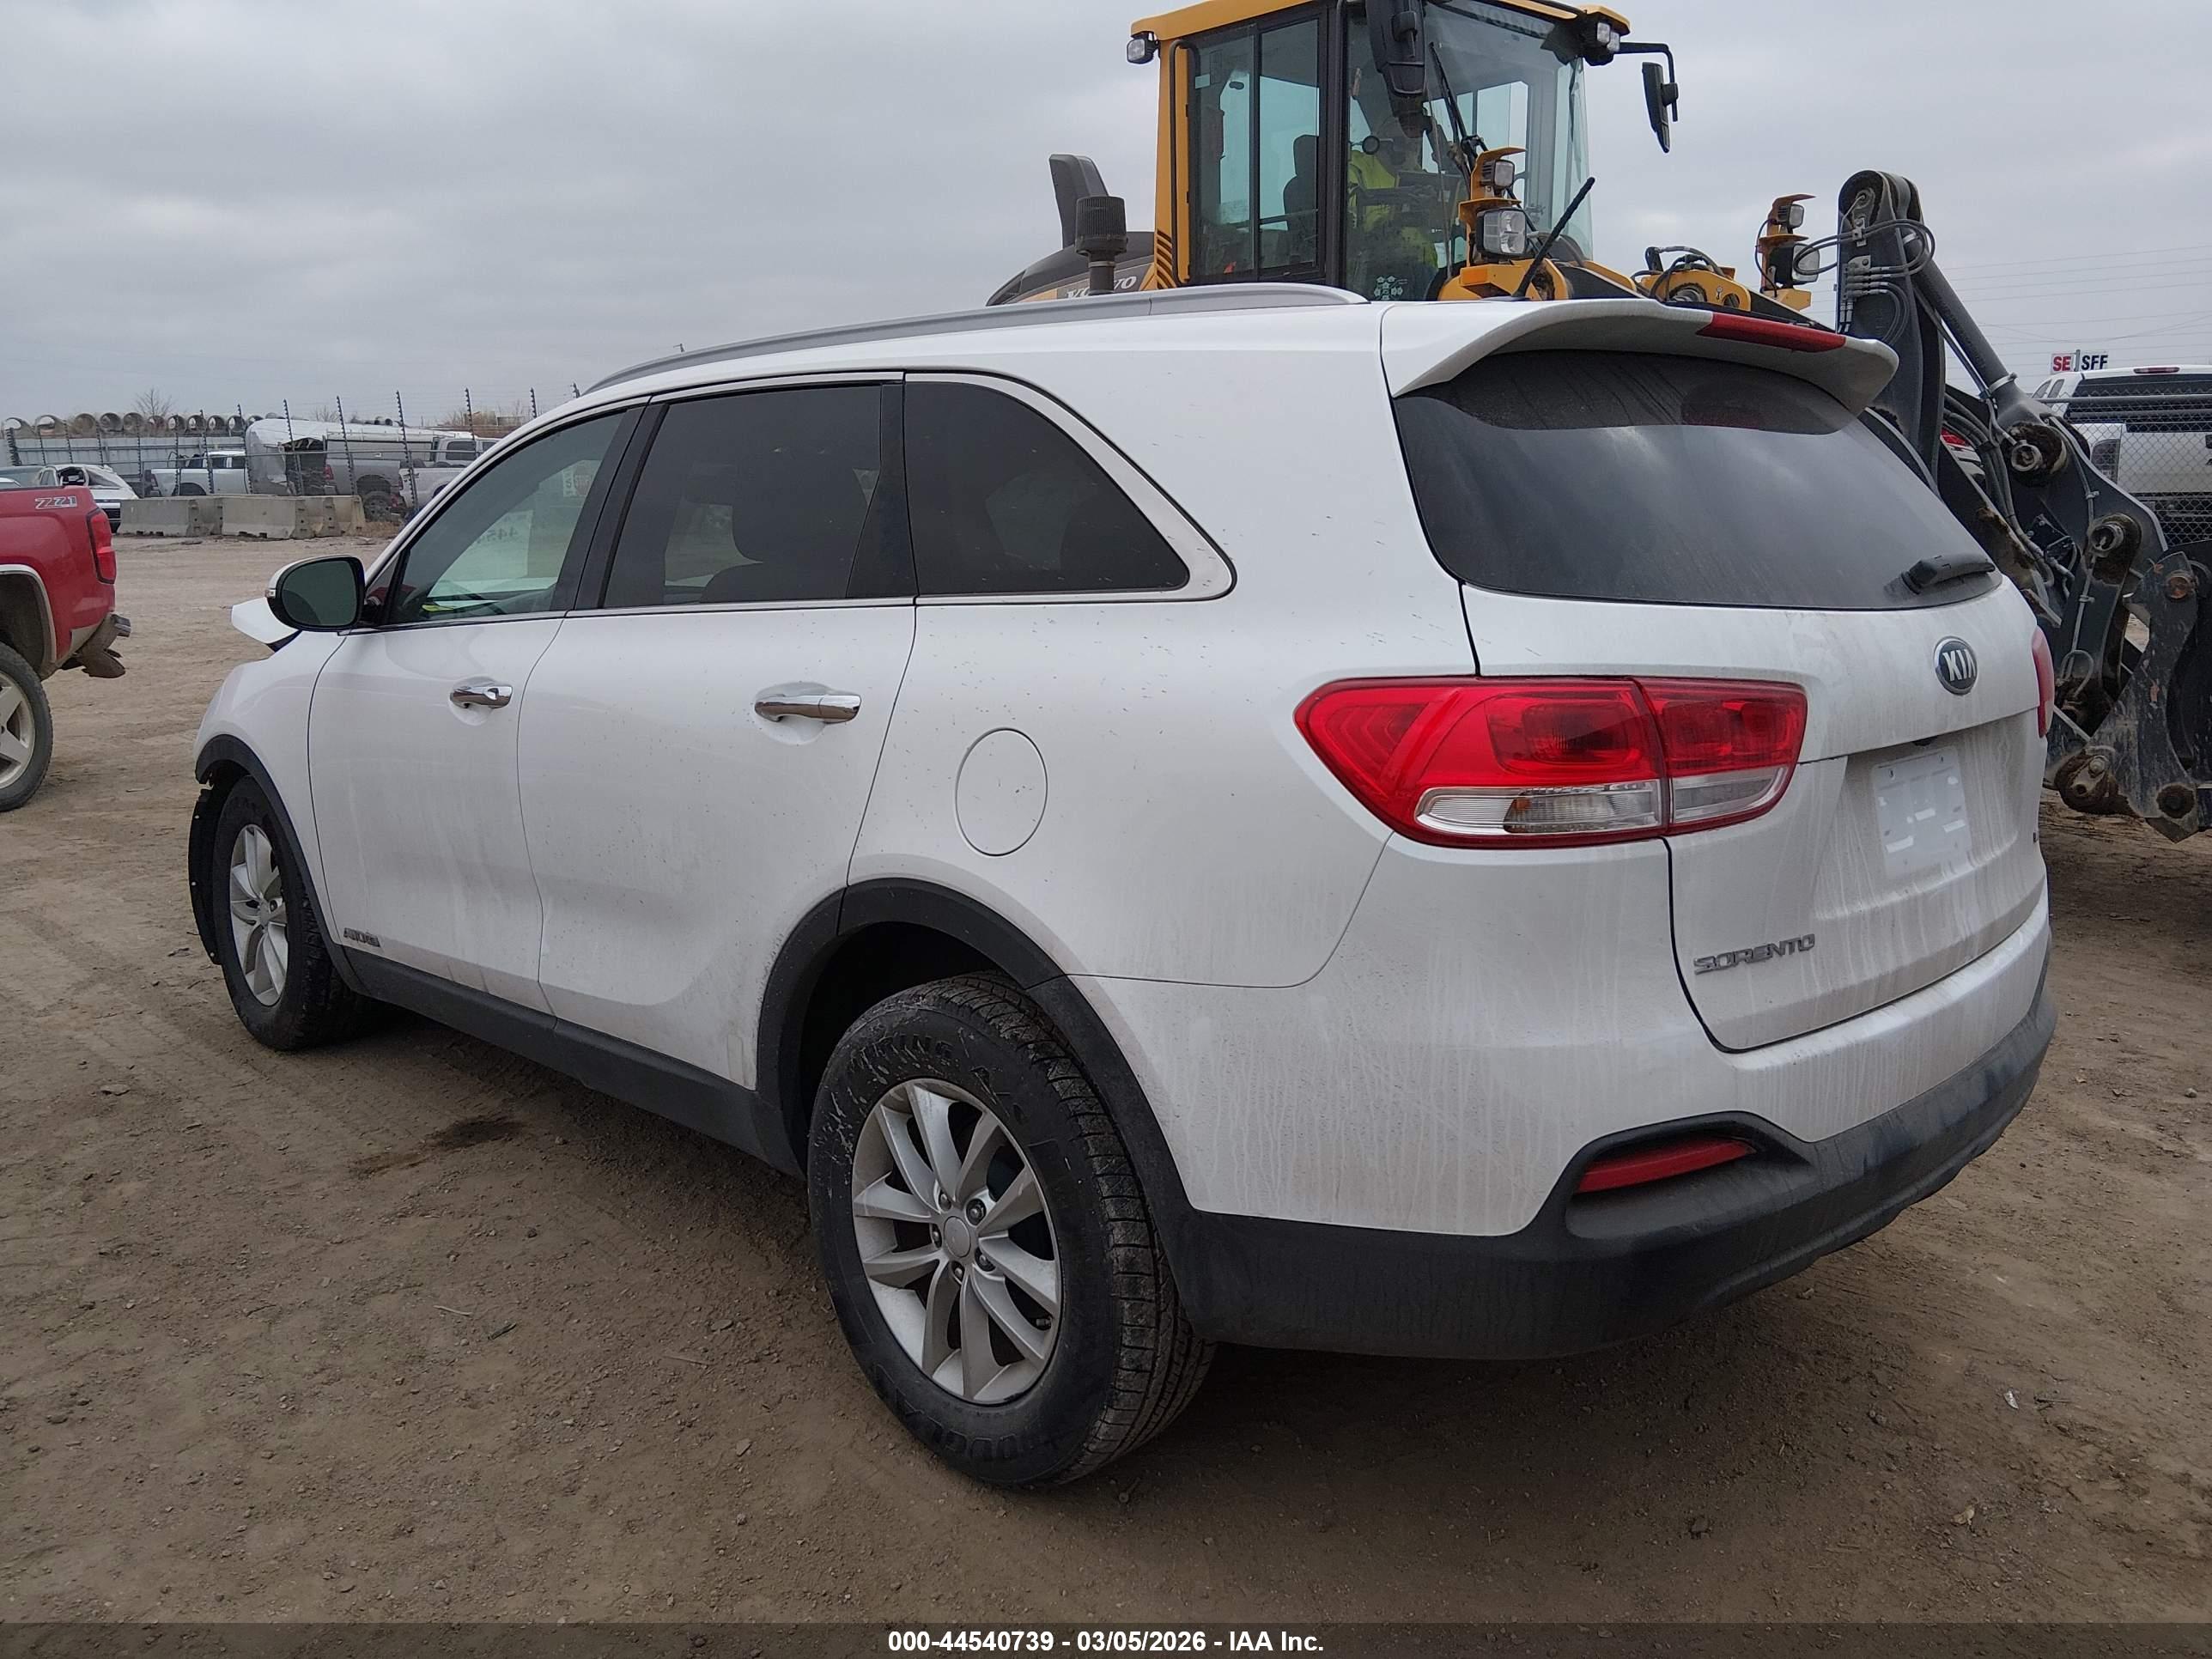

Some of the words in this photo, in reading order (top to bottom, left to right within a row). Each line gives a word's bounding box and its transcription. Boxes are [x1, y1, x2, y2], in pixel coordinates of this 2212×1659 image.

[2052, 356, 2072, 372] SE
[2081, 354, 2109, 371] SFF
[1942, 648, 1977, 682] KIA
[1693, 933, 1815, 975] SORENTO
